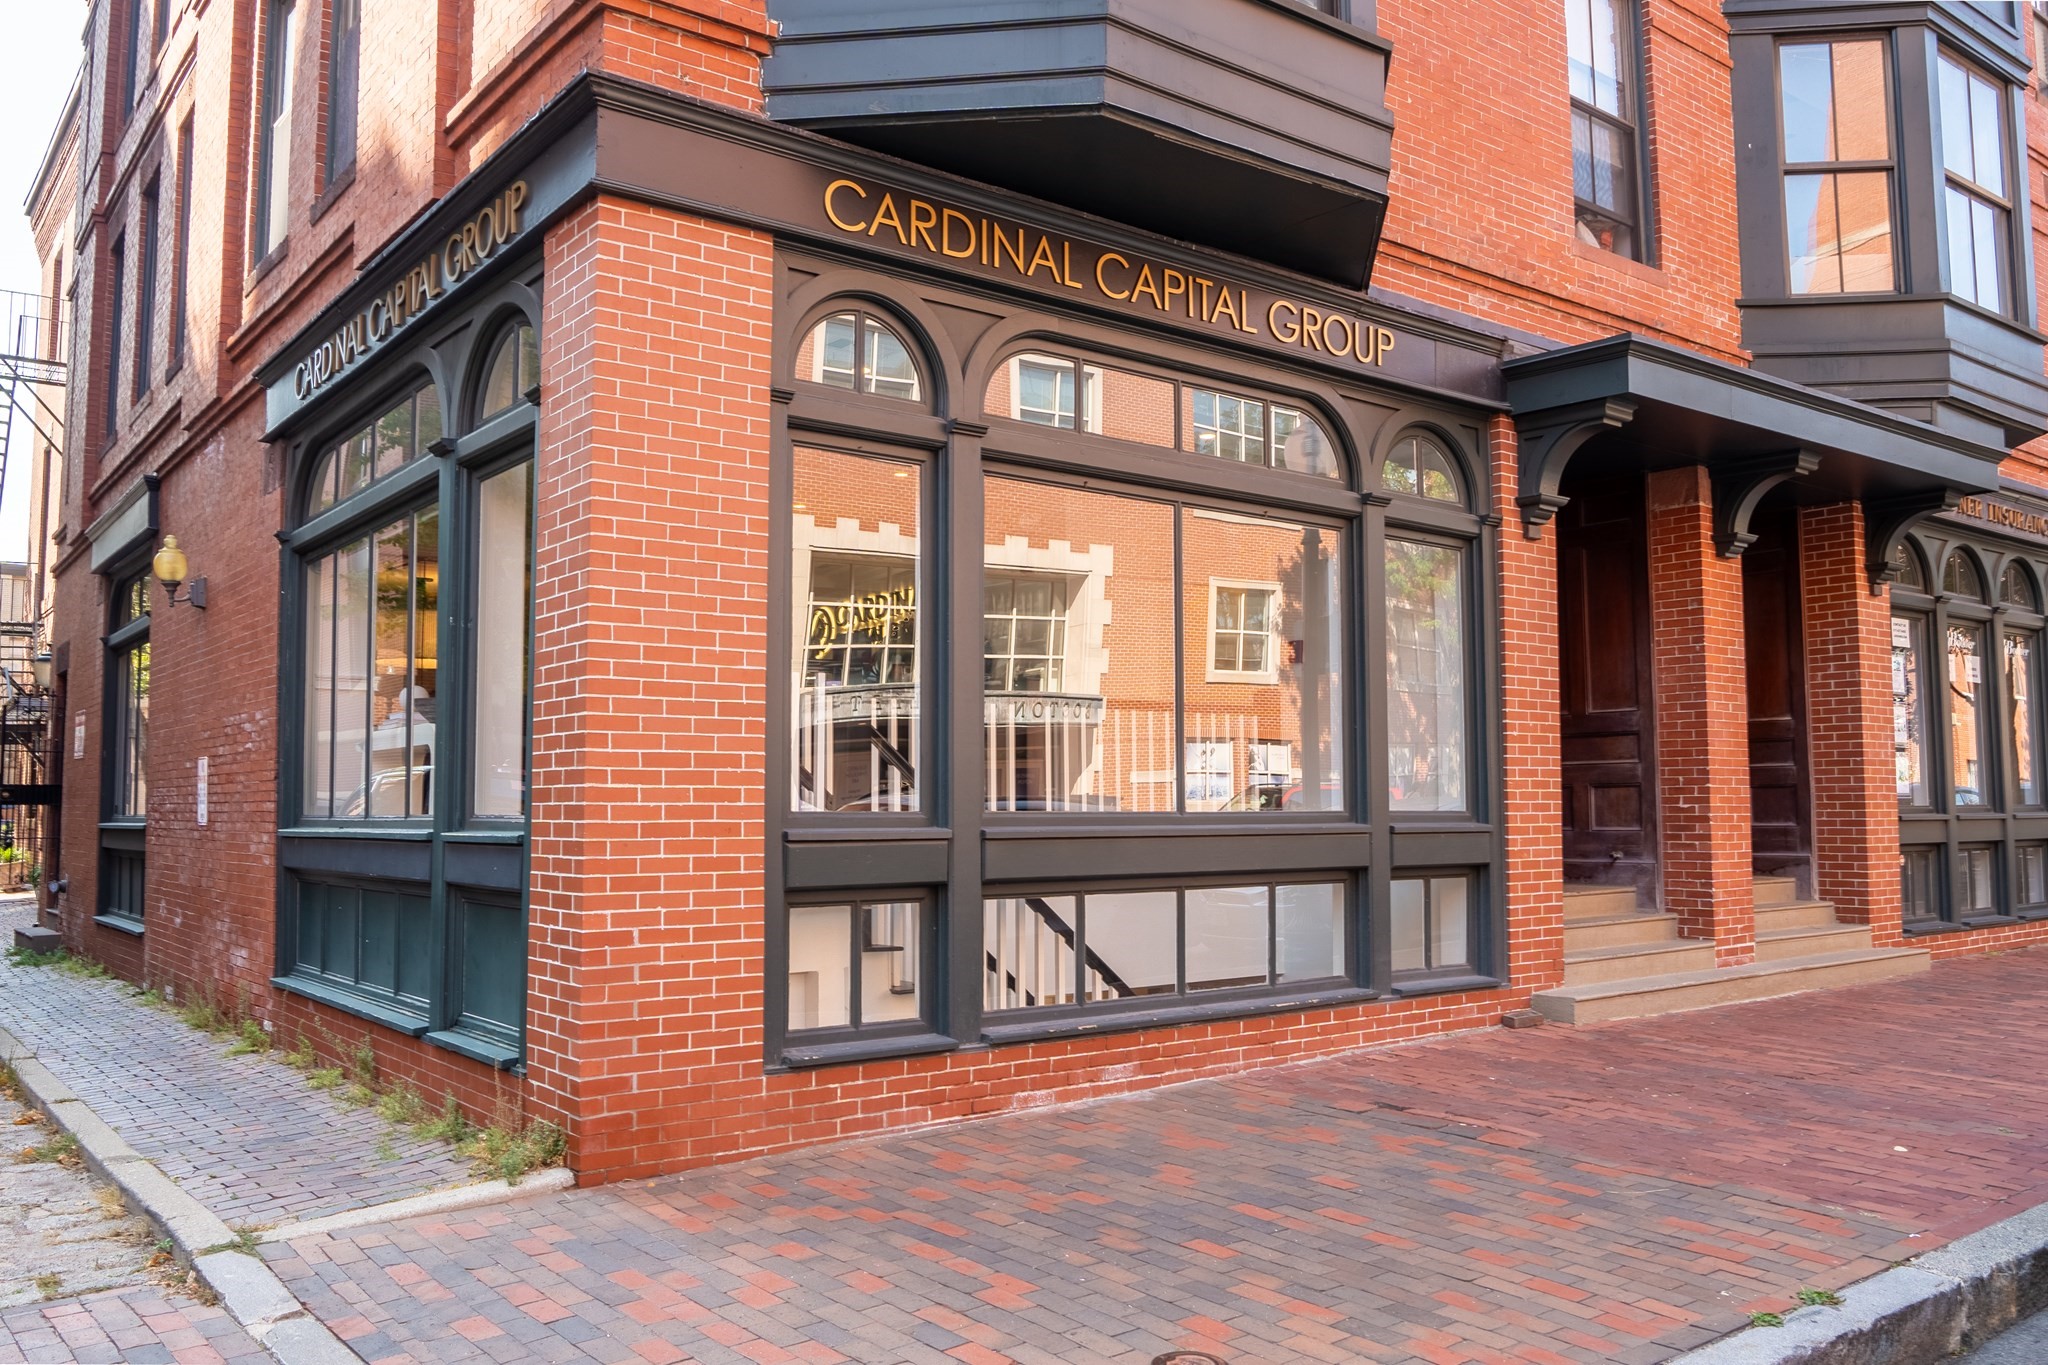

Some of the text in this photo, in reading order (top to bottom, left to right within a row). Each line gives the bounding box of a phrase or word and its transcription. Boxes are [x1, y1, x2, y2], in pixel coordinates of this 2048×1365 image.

[294, 180, 528, 401] CARDINAL CAPITAL GROUP
[824, 179, 1396, 366] CARDINAL CAPITAL GROUP
